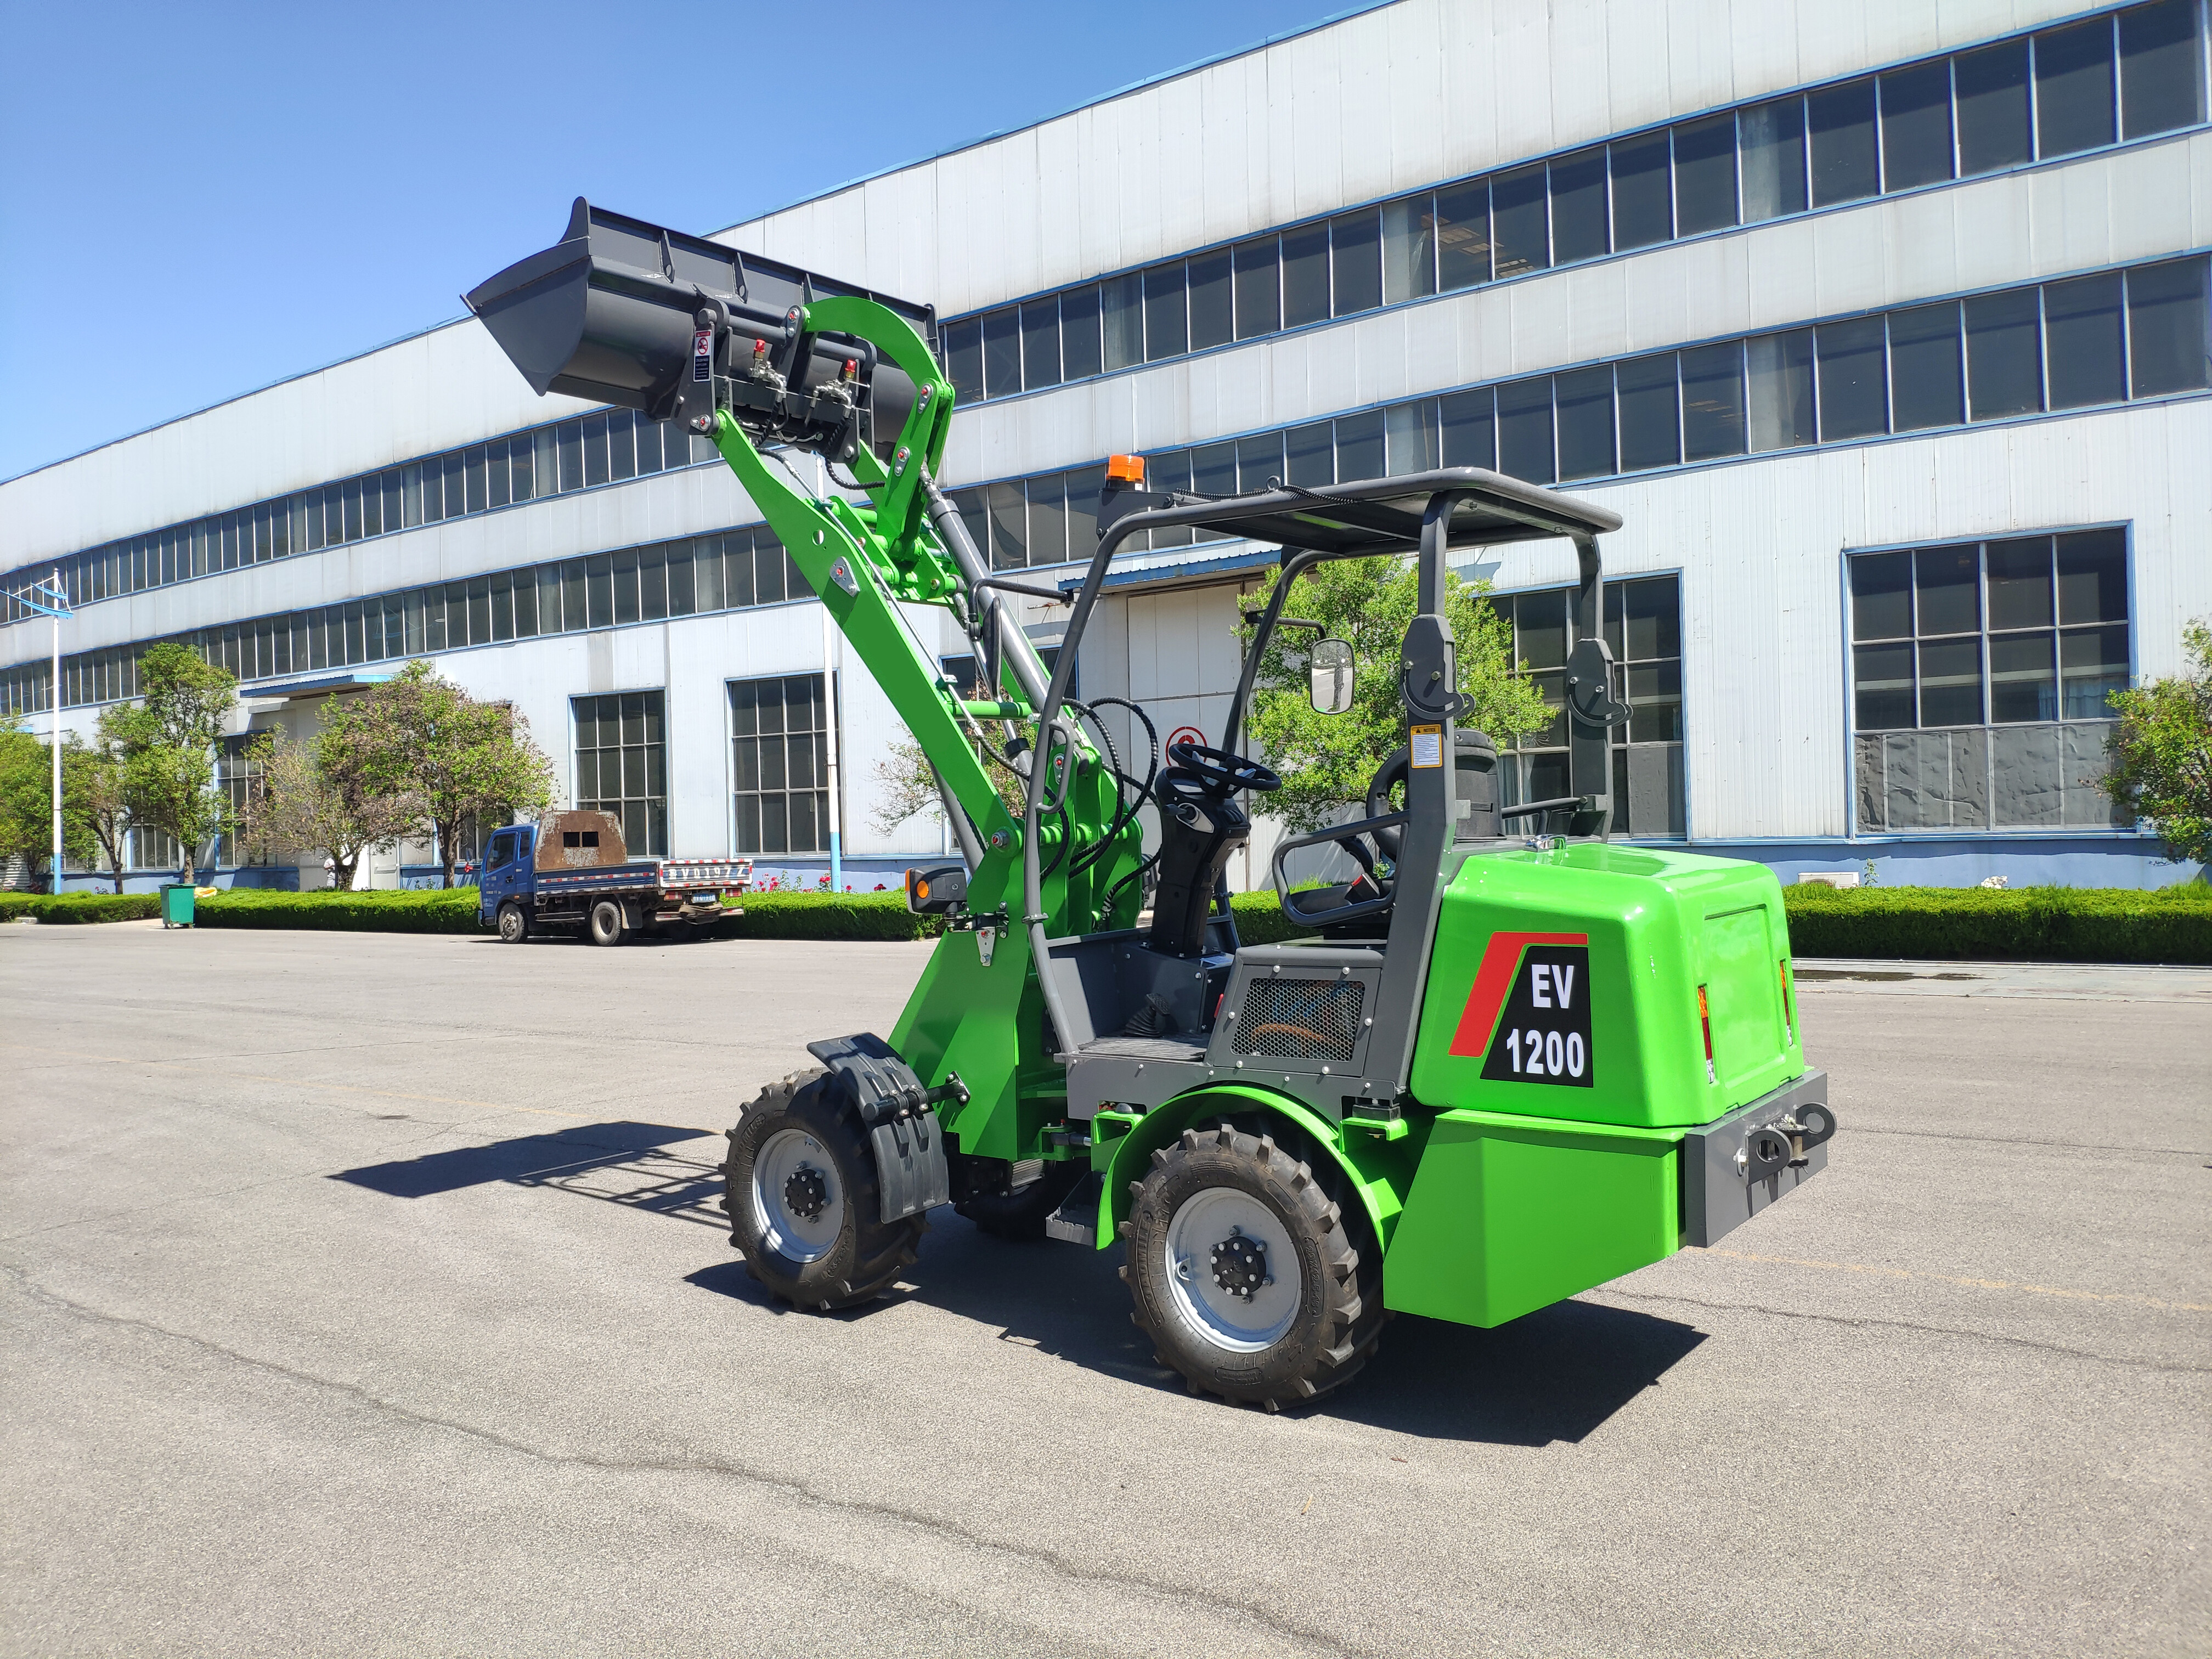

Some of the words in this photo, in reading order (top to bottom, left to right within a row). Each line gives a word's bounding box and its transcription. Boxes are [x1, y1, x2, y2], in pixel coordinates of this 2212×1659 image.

[1531, 964, 1574, 1009] EV
[1506, 1028, 1584, 1077] 1200
[1305, 1246, 1321, 1308] 29X12.5-15
